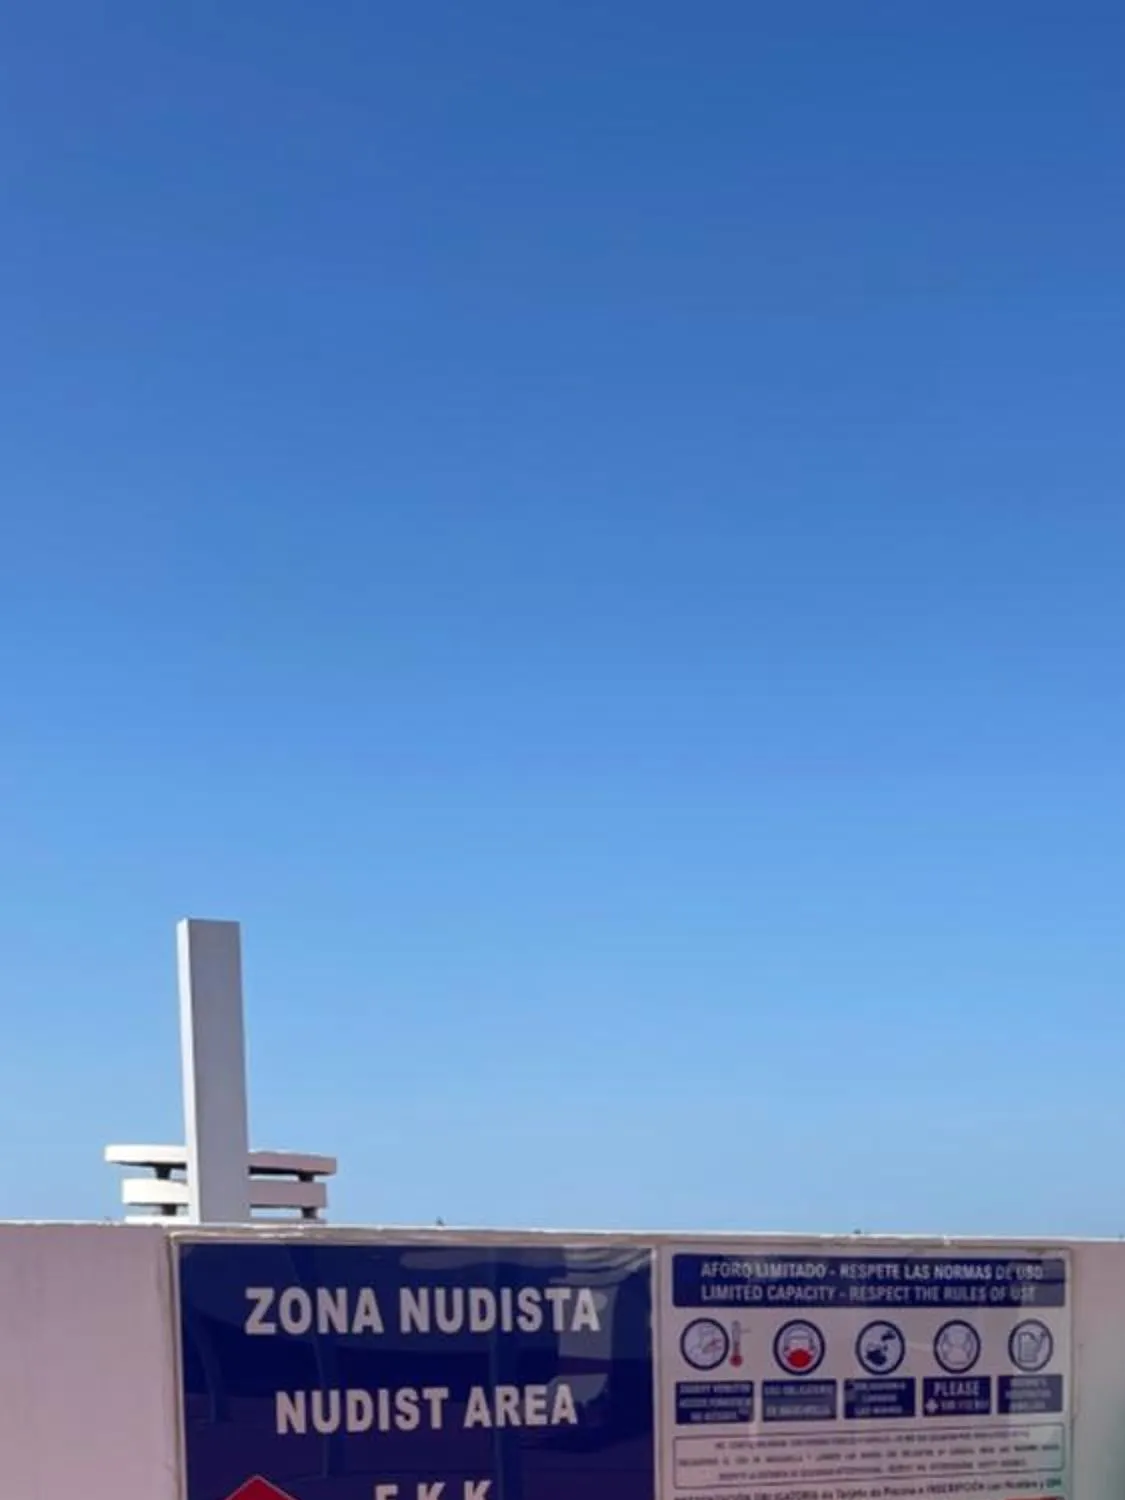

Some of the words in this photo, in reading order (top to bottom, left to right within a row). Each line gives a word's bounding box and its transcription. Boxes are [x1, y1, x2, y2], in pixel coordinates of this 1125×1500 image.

[701, 1263, 751, 1278] AFORO
[752, 1263, 826, 1278] LIMITADO
[840, 1263, 899, 1279] RESPETE
[904, 1264, 930, 1279] LAS
[934, 1264, 992, 1279] NORMAS
[1015, 1265, 1043, 1280] USO
[701, 1285, 763, 1300] LIMITED
[767, 1285, 837, 1300] CAPACITY
[850, 1285, 910, 1300] RESPECT
[916, 1286, 939, 1301] THE
[943, 1286, 987, 1300] RULES
[989, 1286, 1006, 1300] OF
[1011, 1286, 1036, 1301] USE
[245, 1287, 384, 1336] ZONA
[400, 1287, 600, 1333] NUDISTA
[933, 1381, 980, 1397] PLEASE
[276, 1387, 449, 1435] NUDIST
[463, 1383, 578, 1428] AREA
